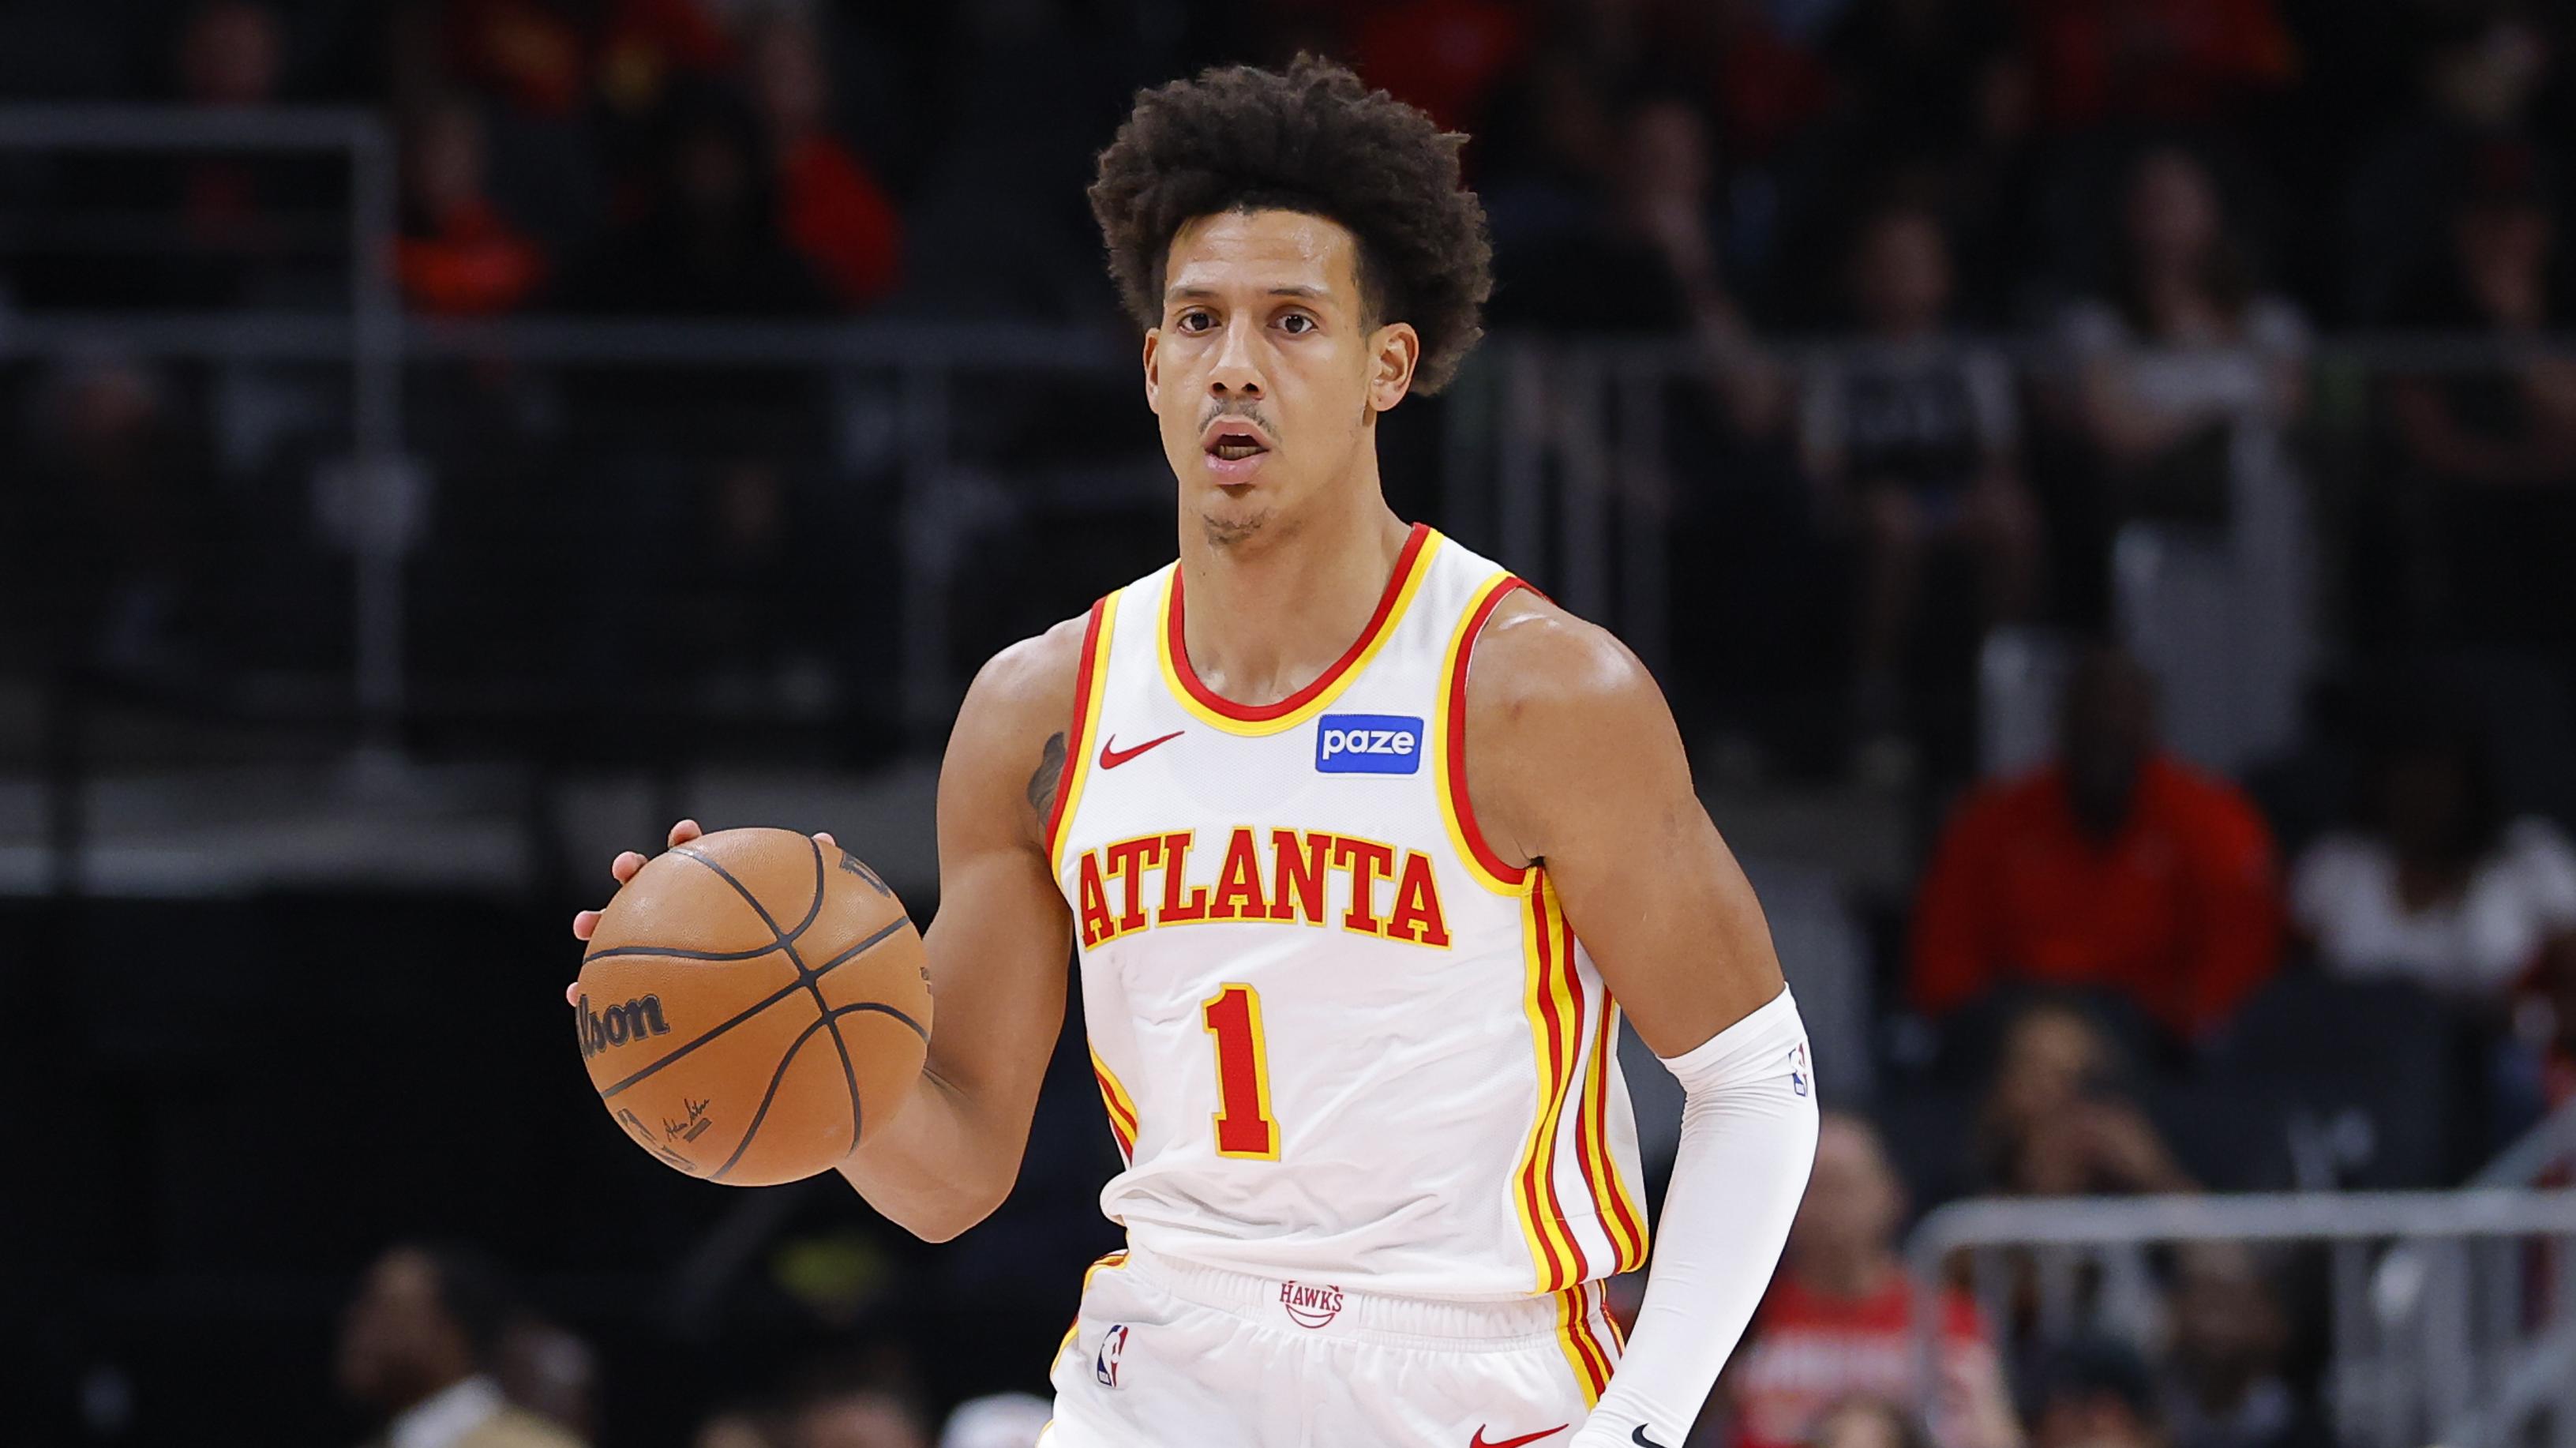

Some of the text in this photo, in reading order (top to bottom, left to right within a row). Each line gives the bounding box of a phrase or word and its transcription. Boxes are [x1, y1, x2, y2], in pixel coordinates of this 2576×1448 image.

[1322, 730, 1415, 760] paze
[1079, 825, 1453, 952] ATLANTA
[576, 993, 670, 1058] lson
[1201, 981, 1281, 1162] 1
[1280, 1282, 1344, 1312] HAWKS
